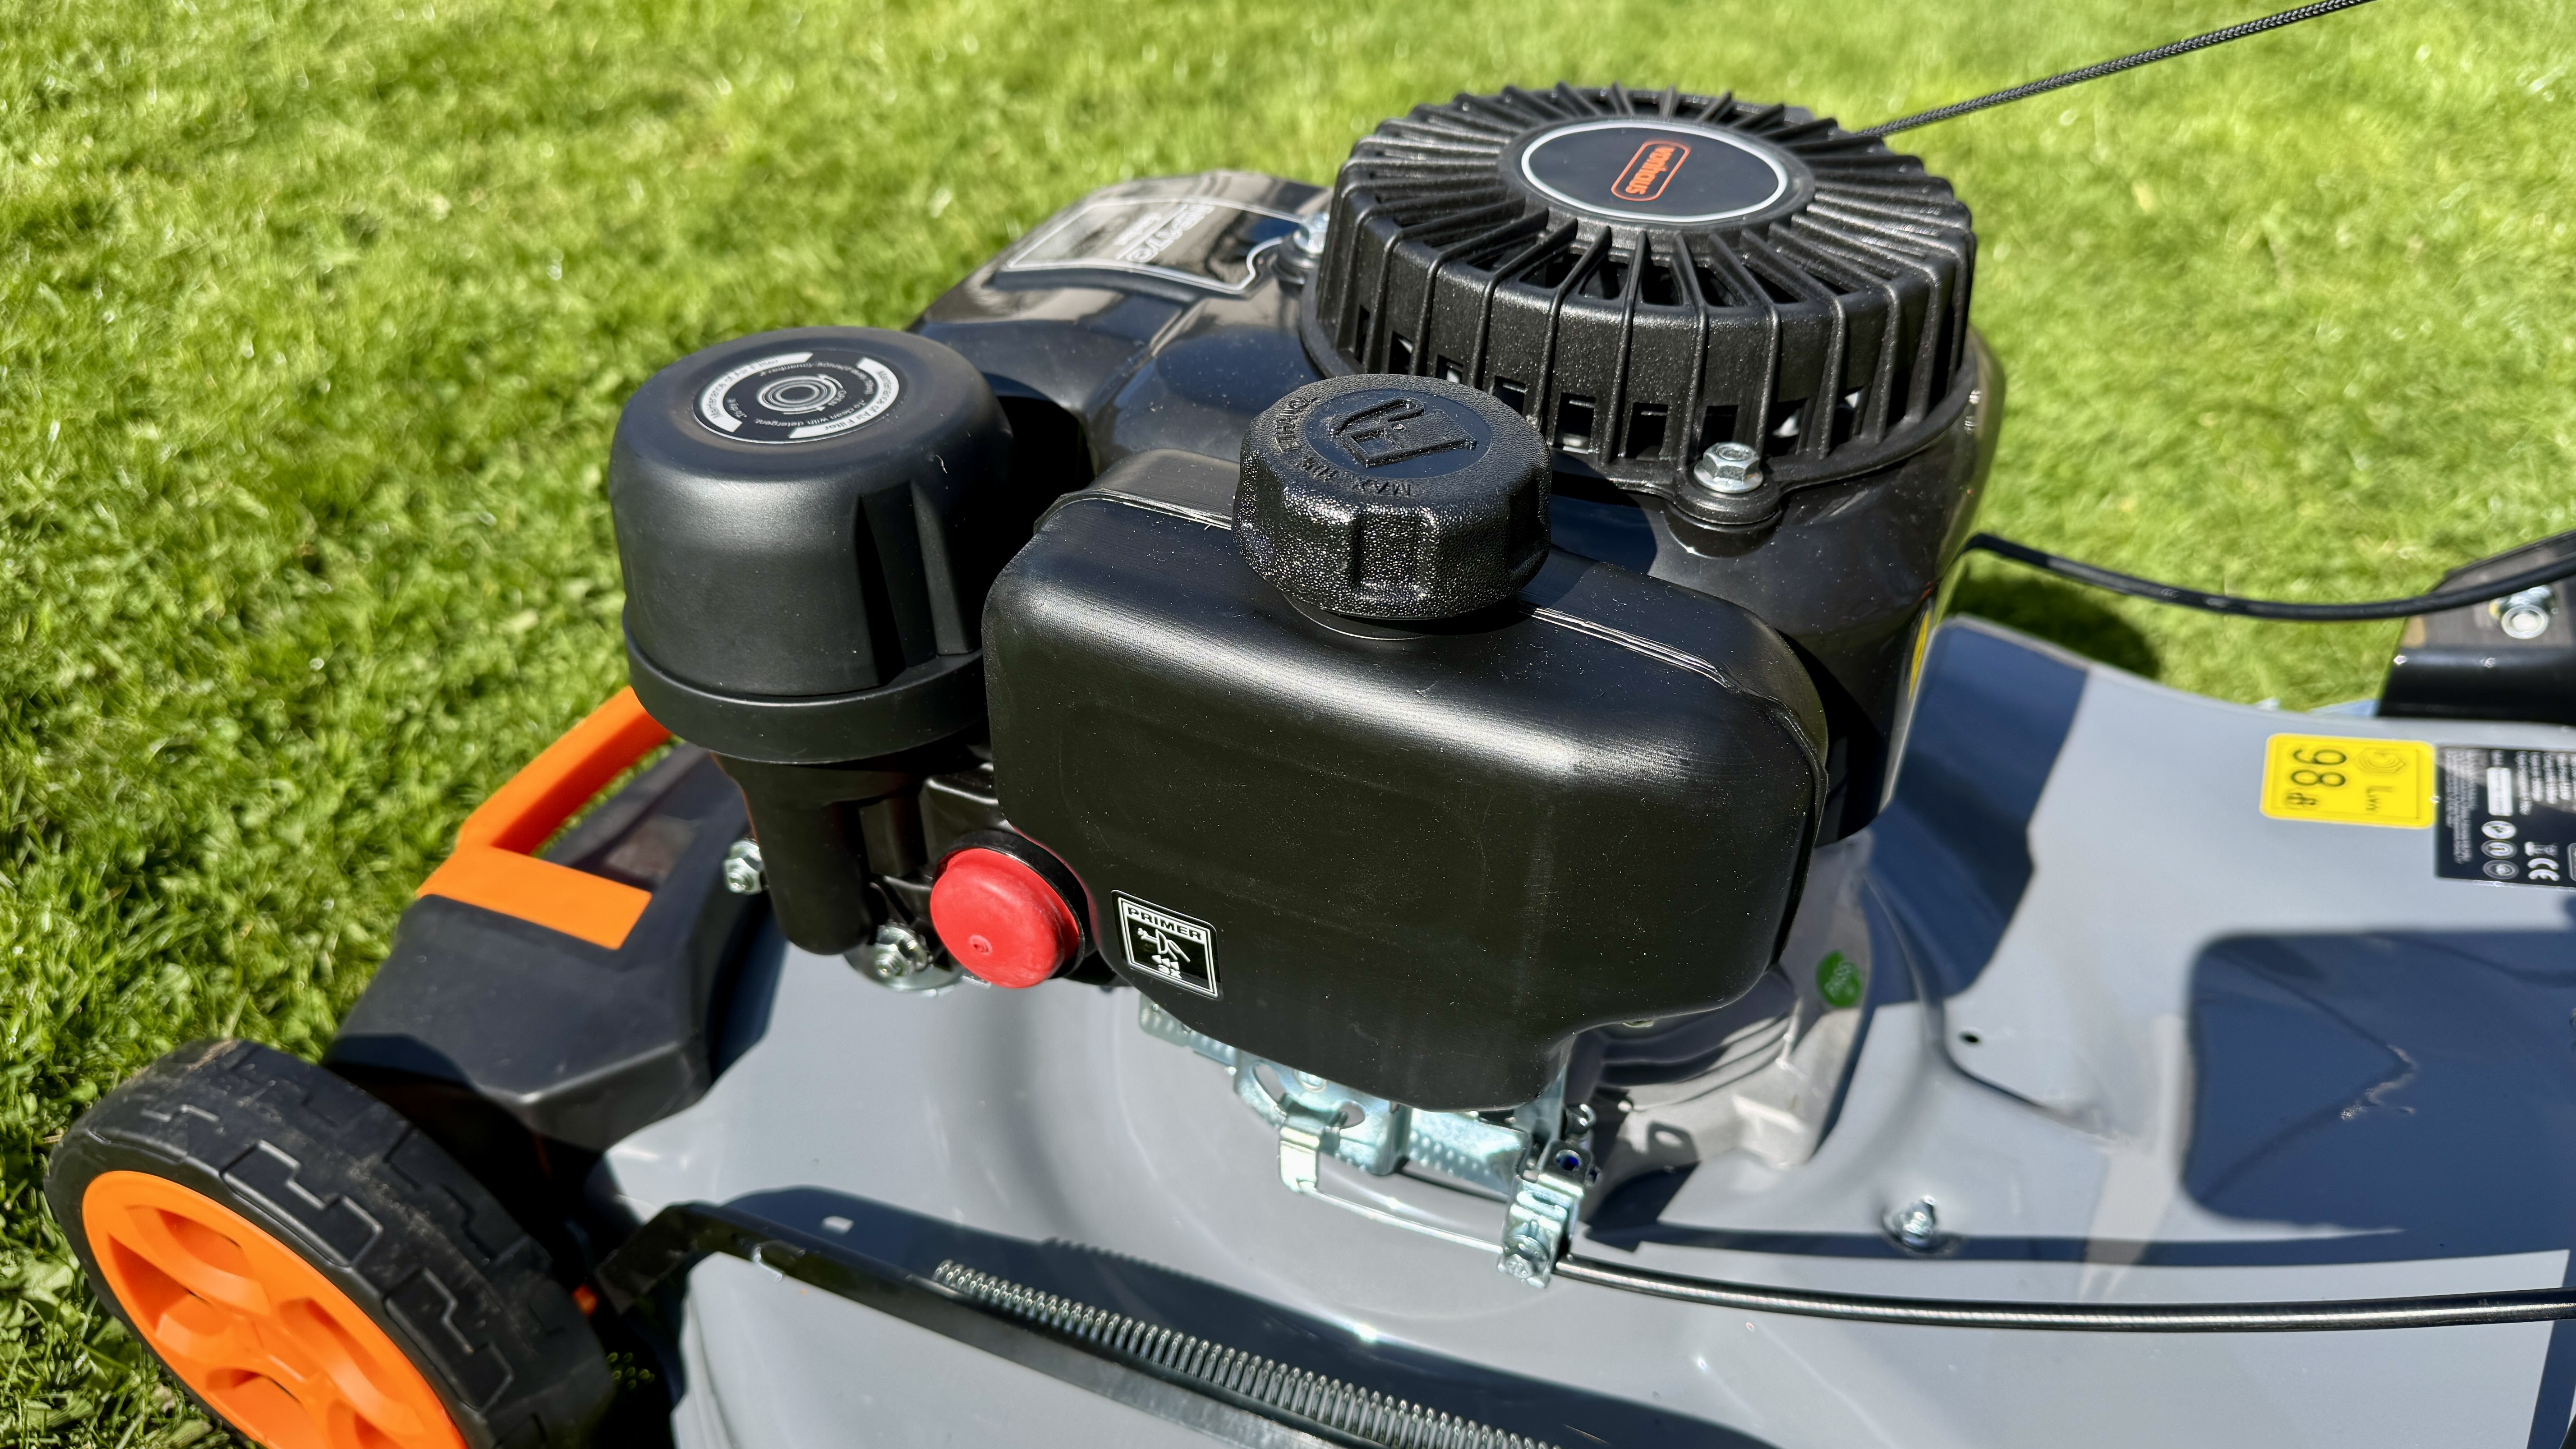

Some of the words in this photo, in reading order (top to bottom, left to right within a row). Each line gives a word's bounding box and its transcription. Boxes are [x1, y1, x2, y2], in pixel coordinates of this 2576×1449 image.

[1625, 147, 1675, 194] vonhaus
[830, 406, 854, 419] clean
[869, 405, 878, 414] of
[807, 417, 828, 426] with
[855, 411, 870, 423] Air
[824, 418, 855, 431] Filter
[2291, 749, 2347, 787] 98
[1127, 906, 1201, 940] PRIMER
